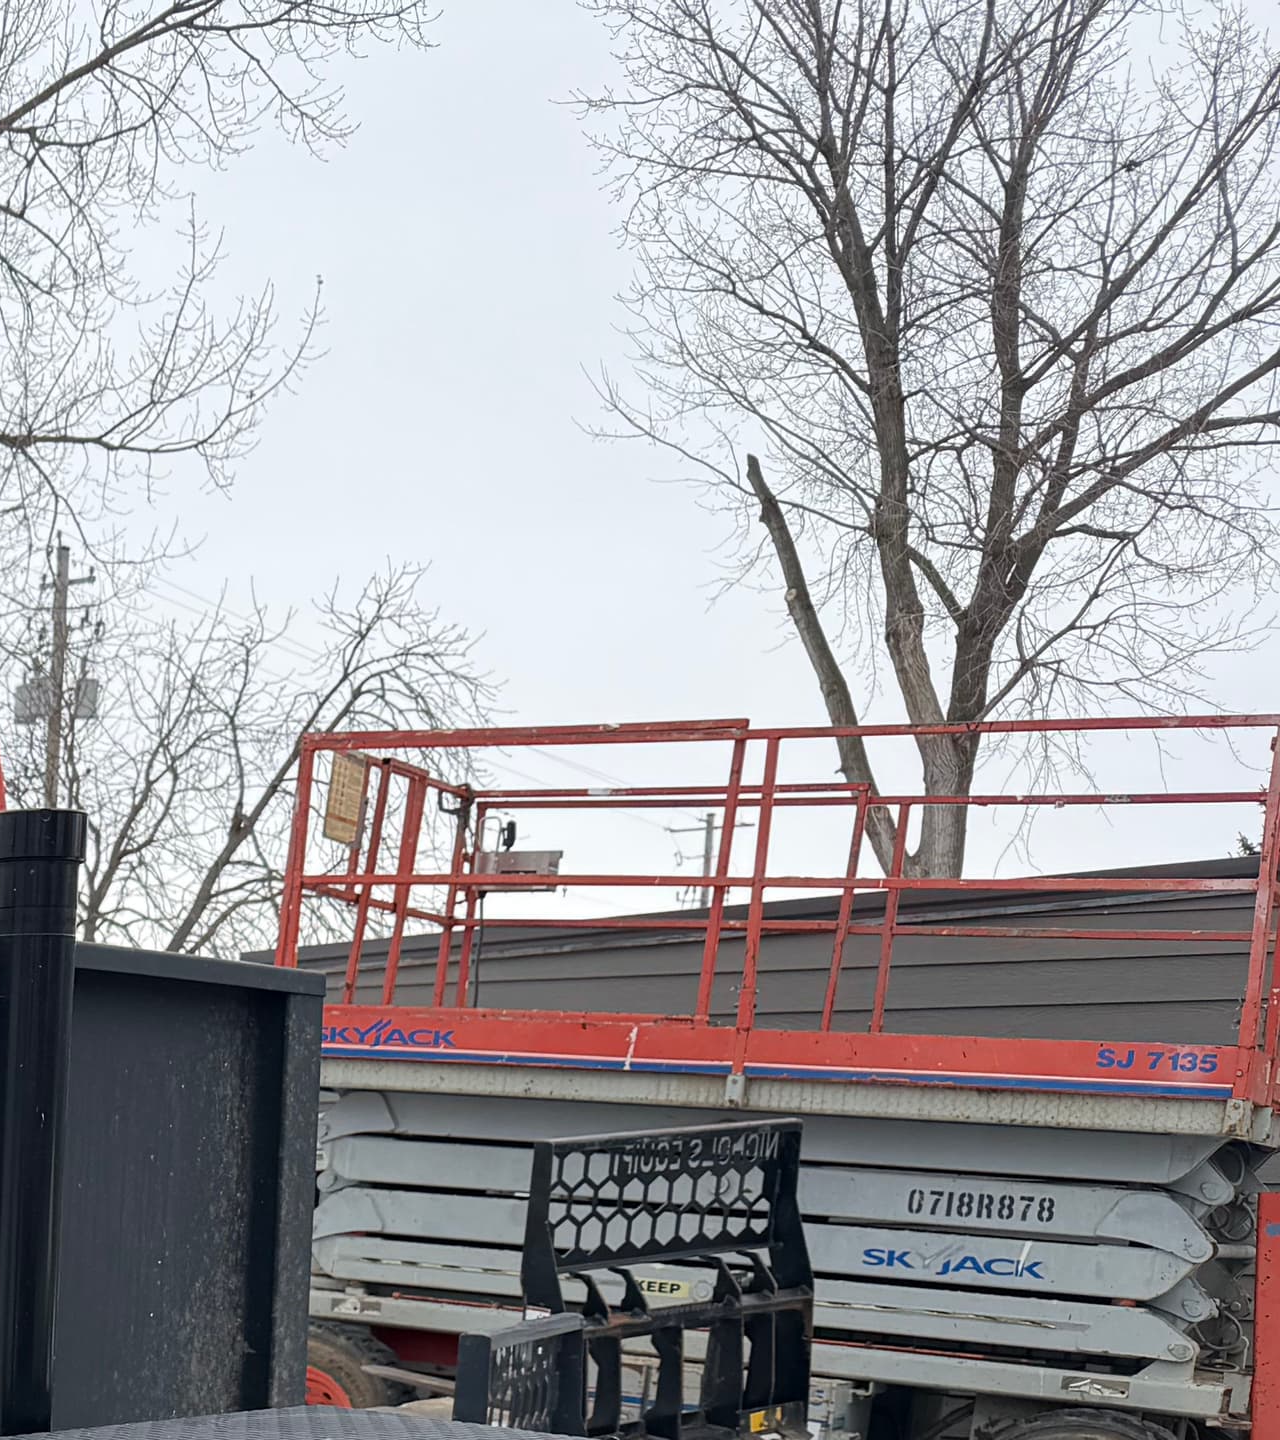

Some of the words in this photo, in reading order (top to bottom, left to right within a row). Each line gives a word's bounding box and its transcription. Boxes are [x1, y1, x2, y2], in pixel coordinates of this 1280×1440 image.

[321, 1018, 457, 1048] SKYJACK
[1096, 1048, 1135, 1069] SJ
[1147, 1051, 1218, 1073] 7135
[907, 1188, 1055, 1223] 0718R878
